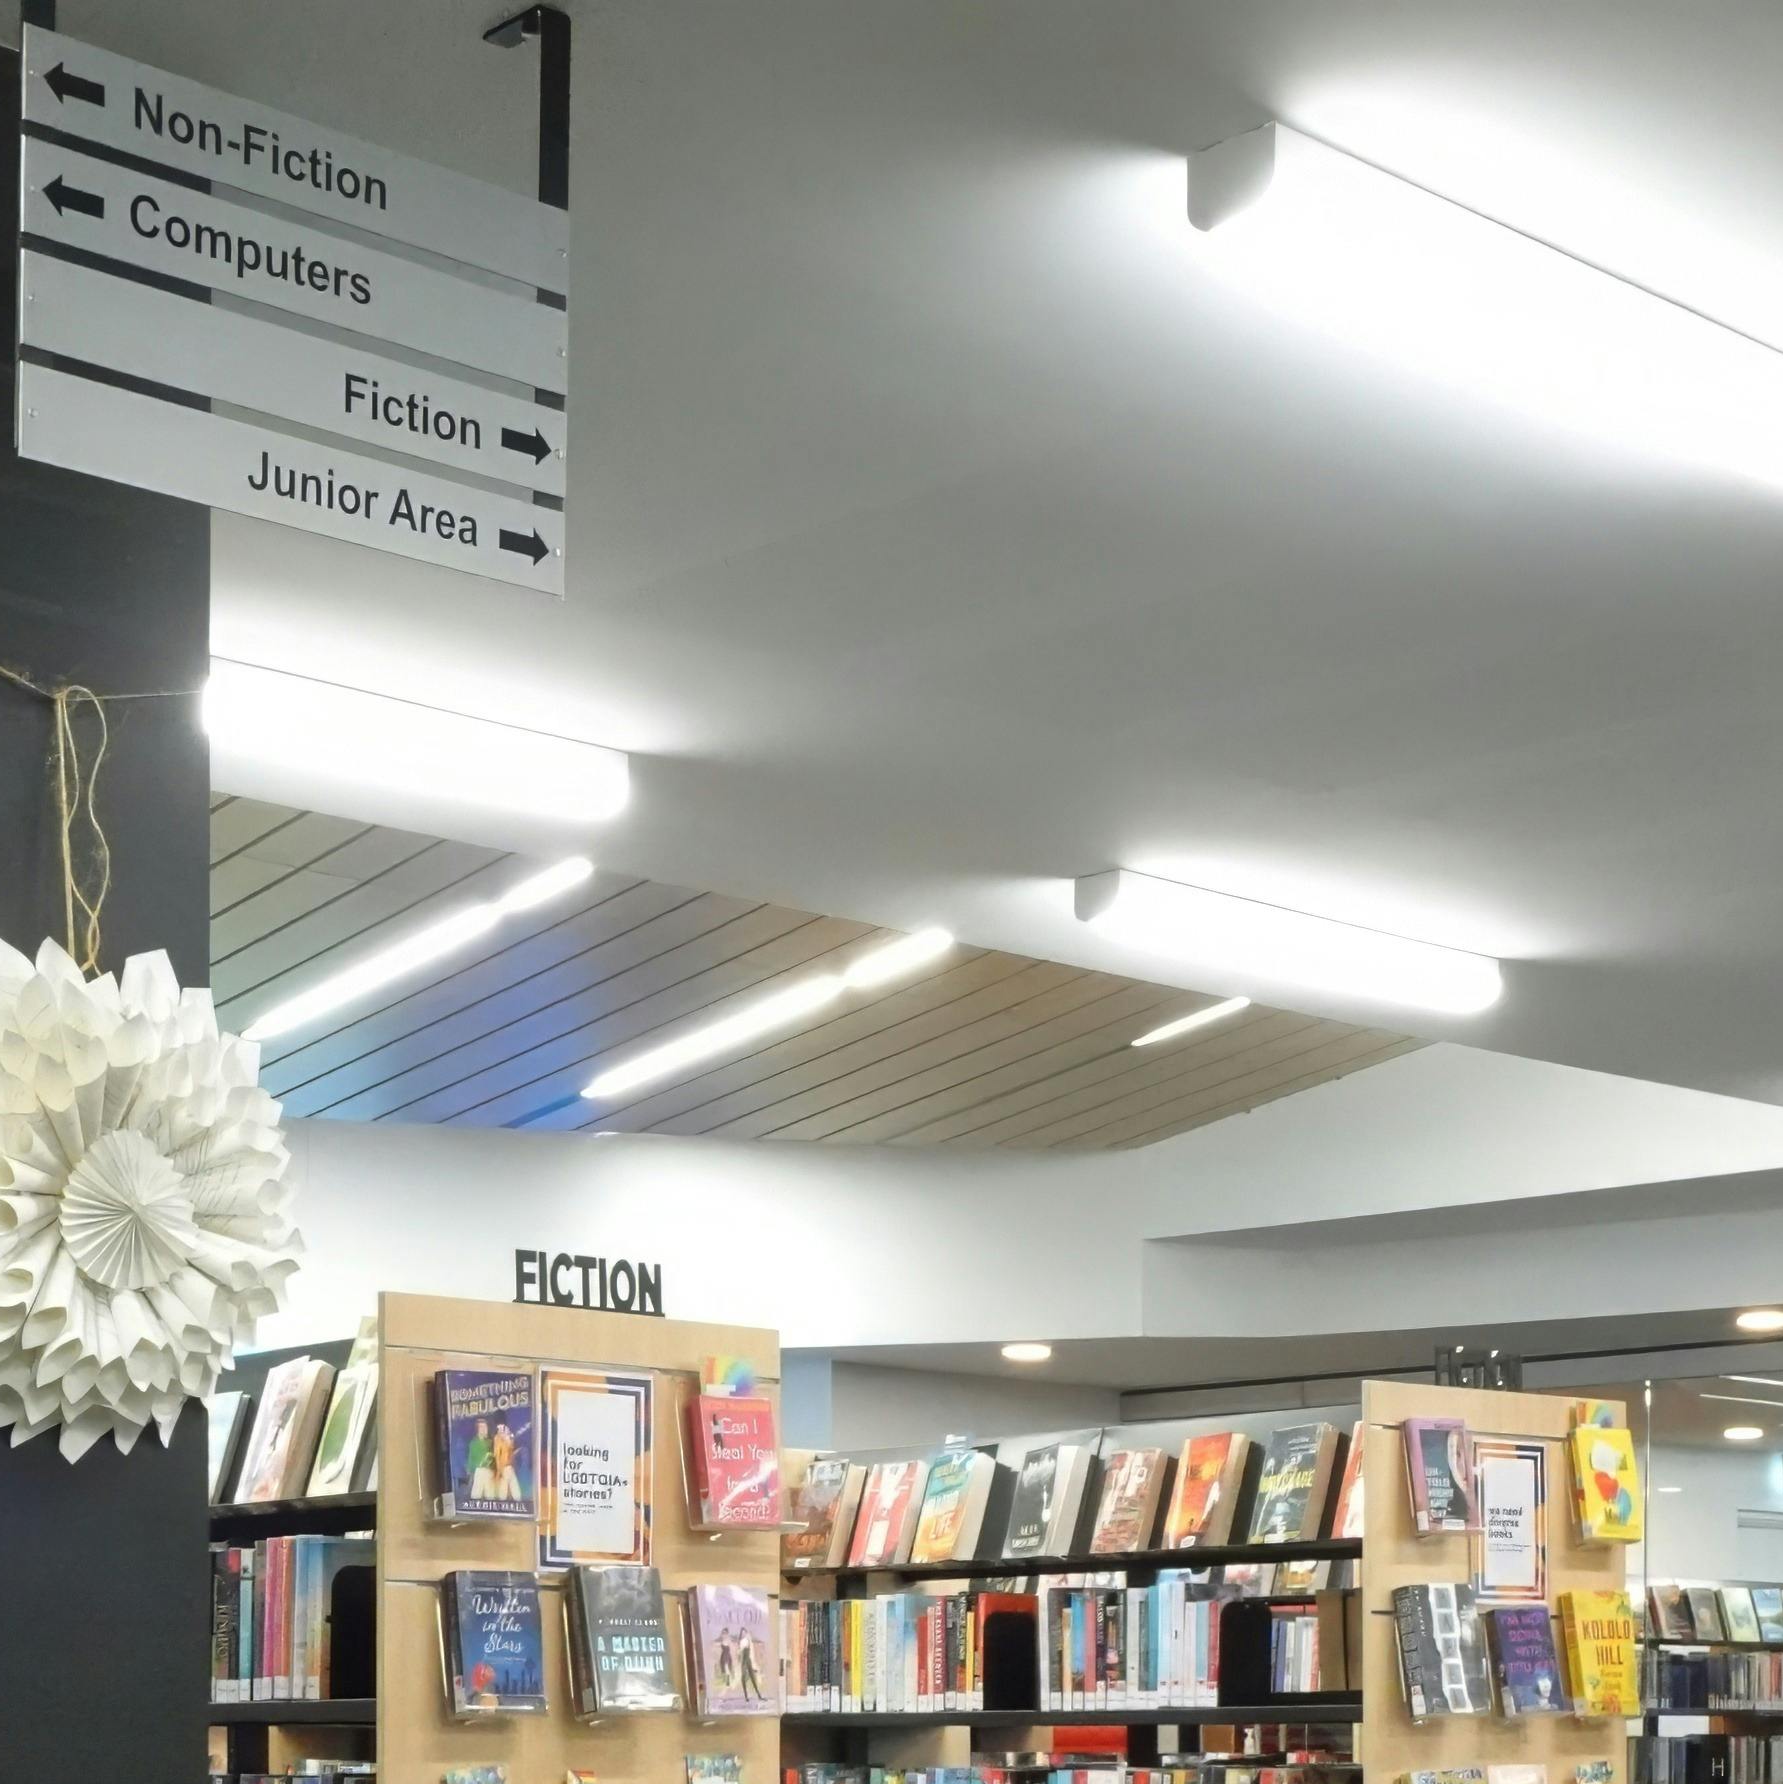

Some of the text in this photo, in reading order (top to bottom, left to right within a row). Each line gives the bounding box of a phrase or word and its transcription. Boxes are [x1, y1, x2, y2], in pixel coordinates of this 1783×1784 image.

[133, 87, 388, 210] Non-Fiction
[129, 194, 372, 305] Computers
[344, 373, 482, 450] Fiction
[248, 451, 478, 547] Junior Area
[514, 1249, 664, 1315] FICTION
[563, 1442, 609, 1462] looking
[1583, 1620, 1631, 1640] KOLOLO
